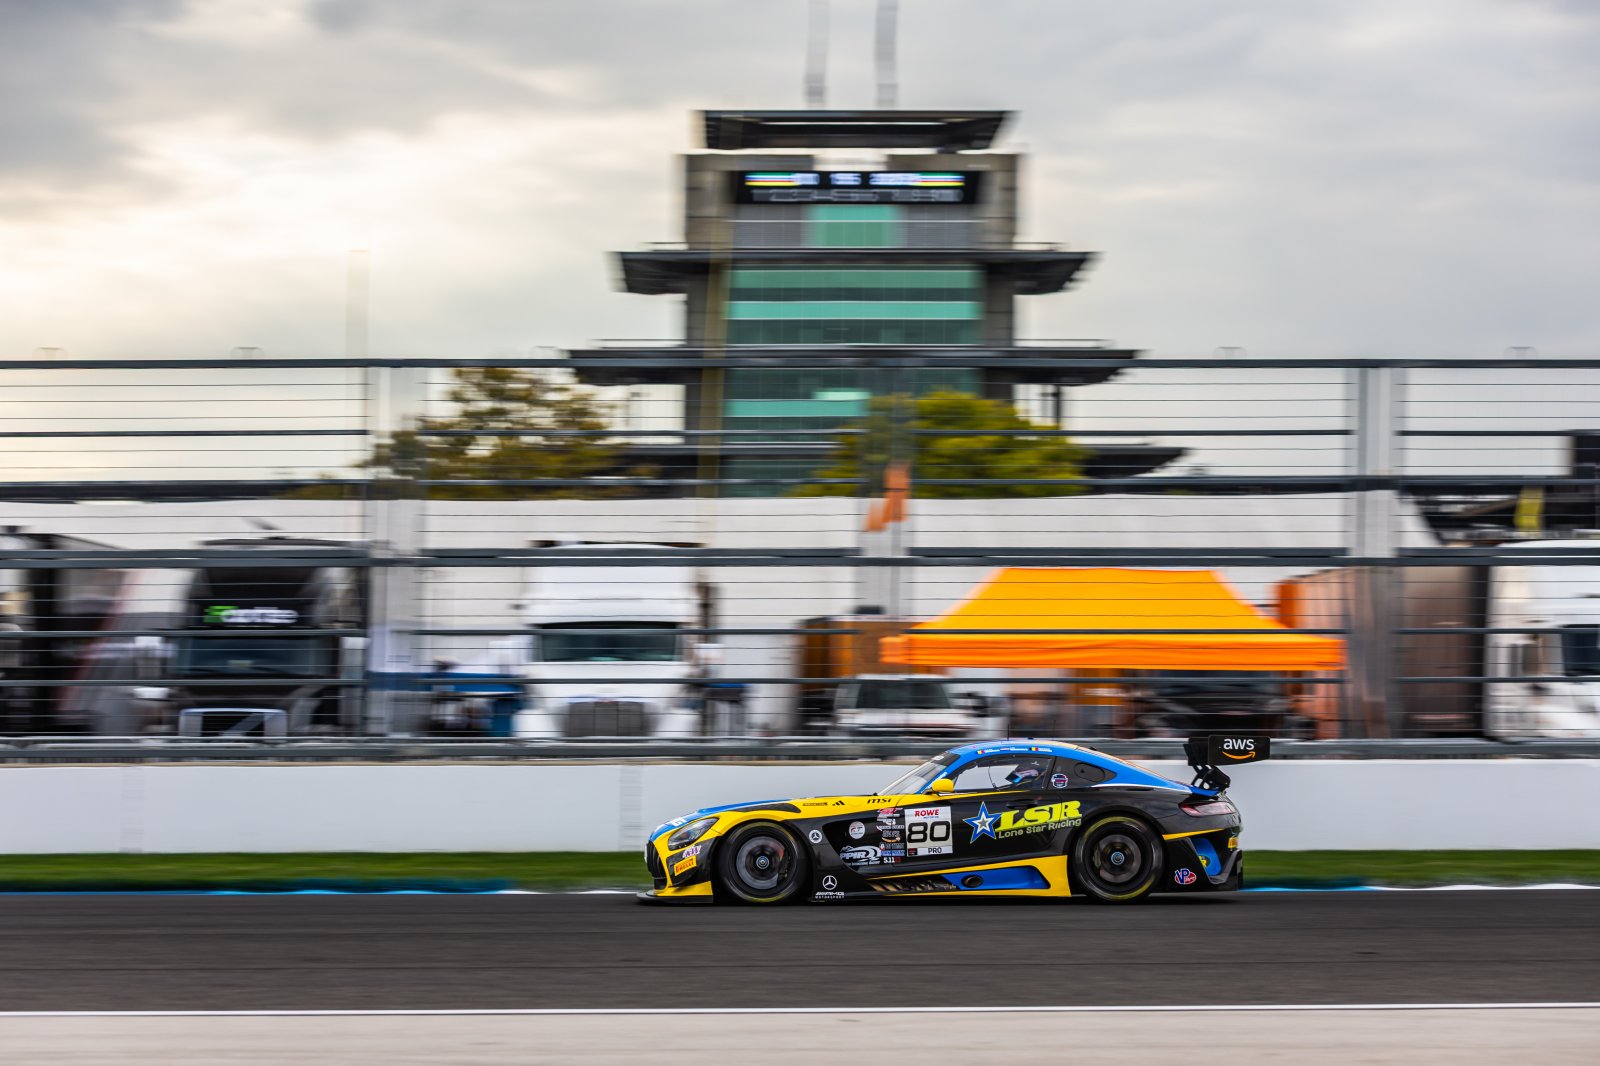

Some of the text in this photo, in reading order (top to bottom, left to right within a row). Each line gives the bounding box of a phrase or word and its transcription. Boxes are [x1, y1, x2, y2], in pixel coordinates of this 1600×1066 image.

[1223, 738, 1255, 750] aws
[915, 809, 939, 817] ROWE
[995, 800, 1082, 832] LSR
[907, 821, 950, 843] 80
[998, 818, 1082, 839] Lone Star Racing
